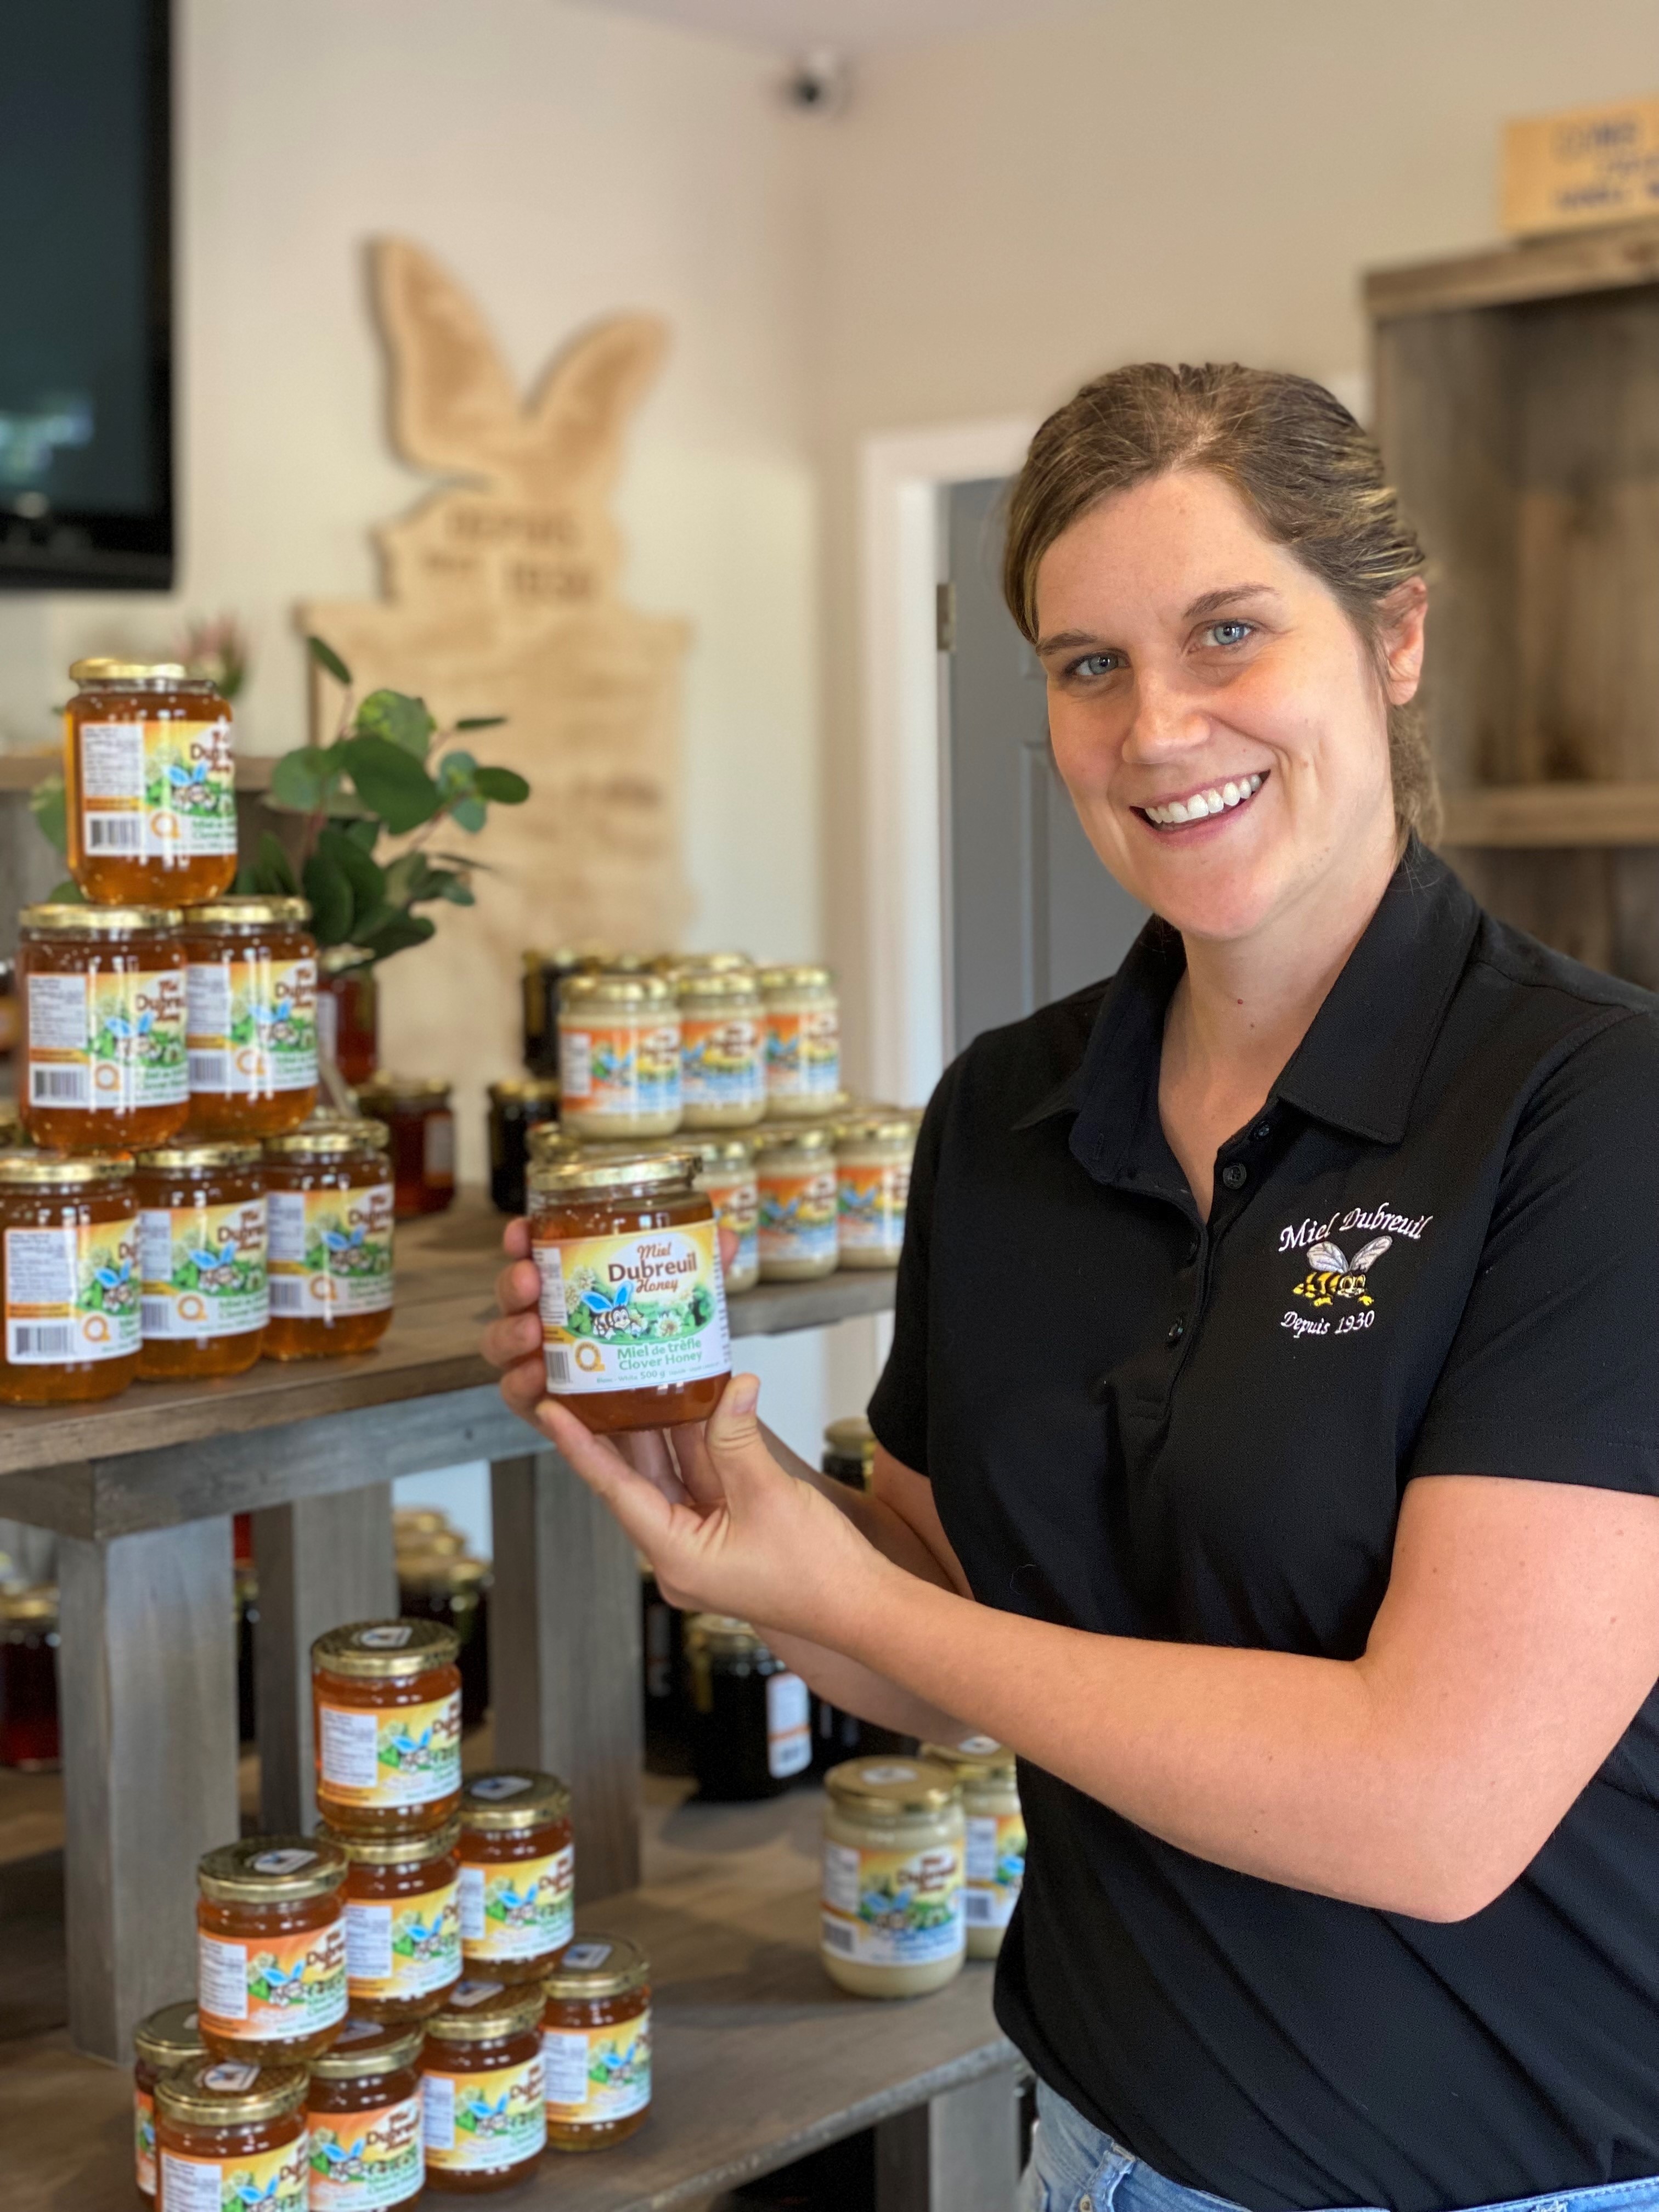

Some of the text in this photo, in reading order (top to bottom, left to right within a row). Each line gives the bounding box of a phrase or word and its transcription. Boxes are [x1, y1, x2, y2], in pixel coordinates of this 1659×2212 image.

[1278, 1202, 1434, 1252] Miel Dubreuil
[637, 1242, 672, 1260] Miel
[608, 1251, 697, 1282] Dubreuil
[636, 1279, 678, 1293] Honey
[1280, 1310, 1375, 1339] Depuis 1930
[617, 1345, 649, 1359] Miel
[651, 1346, 665, 1355] de
[668, 1338, 702, 1353] trèfle
[619, 1351, 702, 1370] Clover Honey
[640, 1370, 657, 1379] 500
